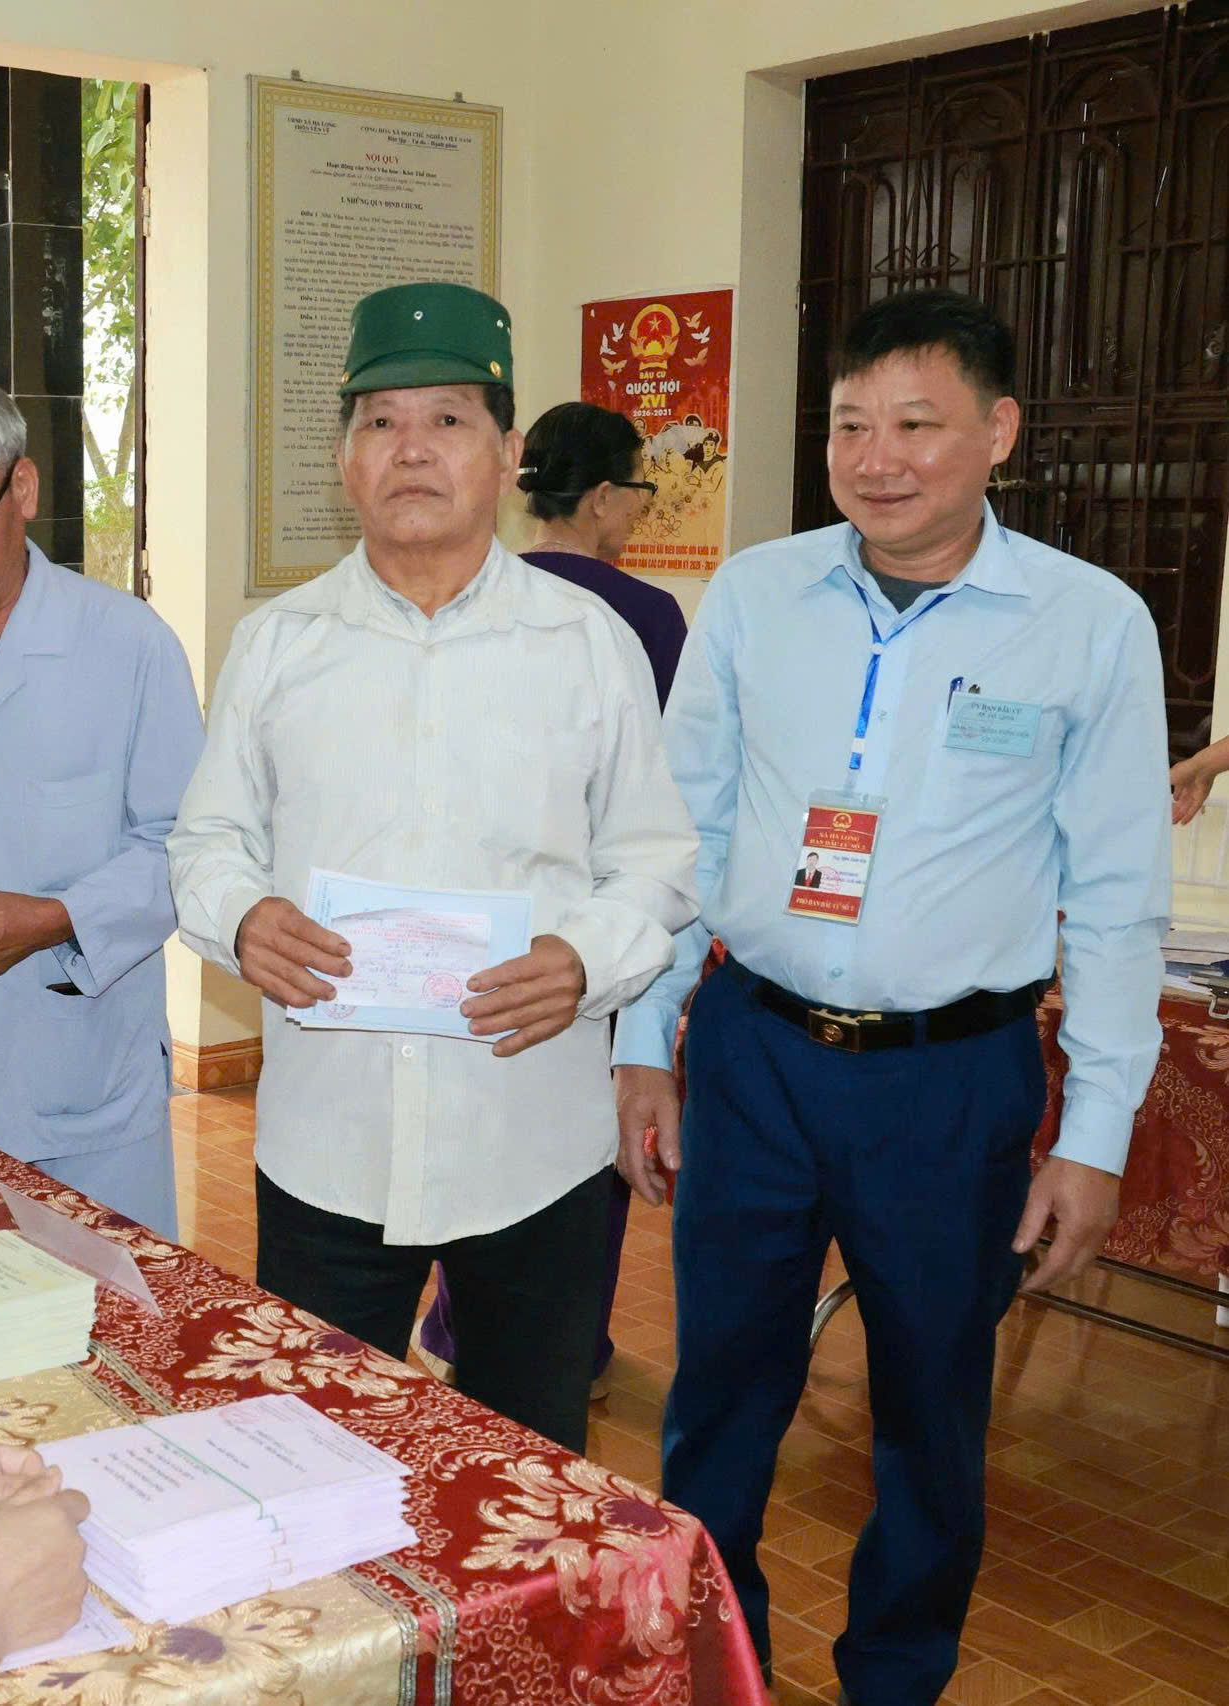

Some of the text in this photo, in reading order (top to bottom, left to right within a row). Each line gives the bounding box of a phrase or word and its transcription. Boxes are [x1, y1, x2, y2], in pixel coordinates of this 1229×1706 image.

[365, 153, 380, 164] NỘI
[639, 370, 654, 379] BẦU
[626, 379, 680, 395] QUỐC HỘI
[640, 394, 666, 408] XVI
[633, 409, 672, 417] 2026-2031
